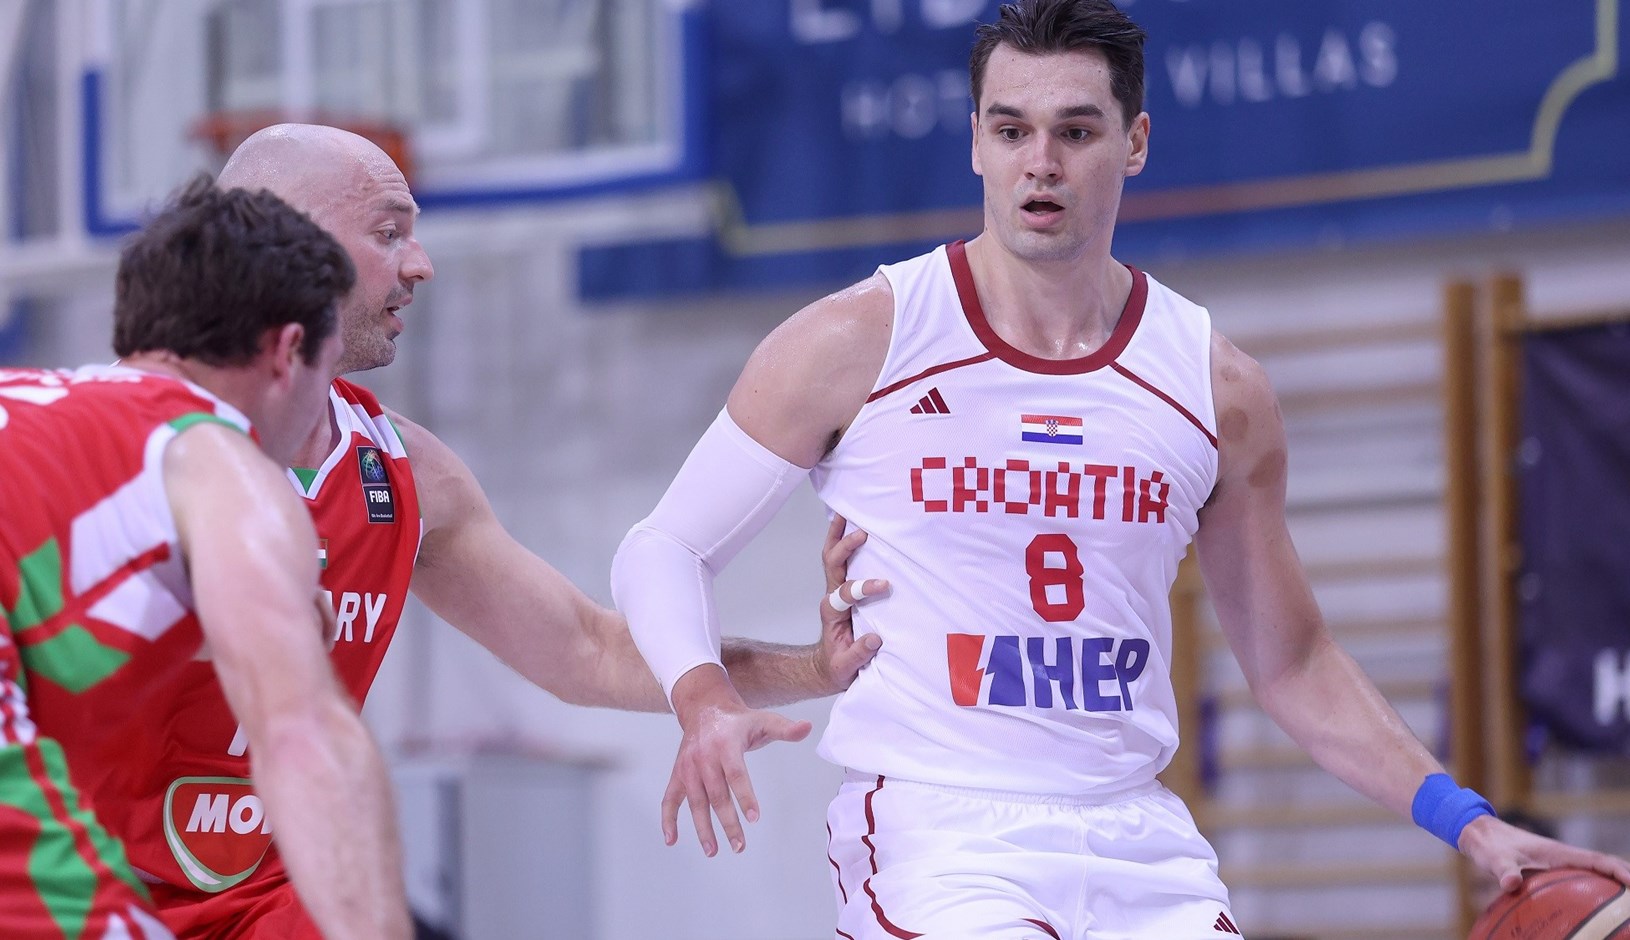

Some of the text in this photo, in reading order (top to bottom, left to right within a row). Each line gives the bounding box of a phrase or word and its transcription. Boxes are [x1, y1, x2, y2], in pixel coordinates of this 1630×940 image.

[1165, 22, 1398, 106] VILLAS
[369, 490, 390, 503] FIBA
[910, 456, 1170, 524] CROATIA
[1025, 533, 1085, 623] 8
[323, 590, 387, 643] RY
